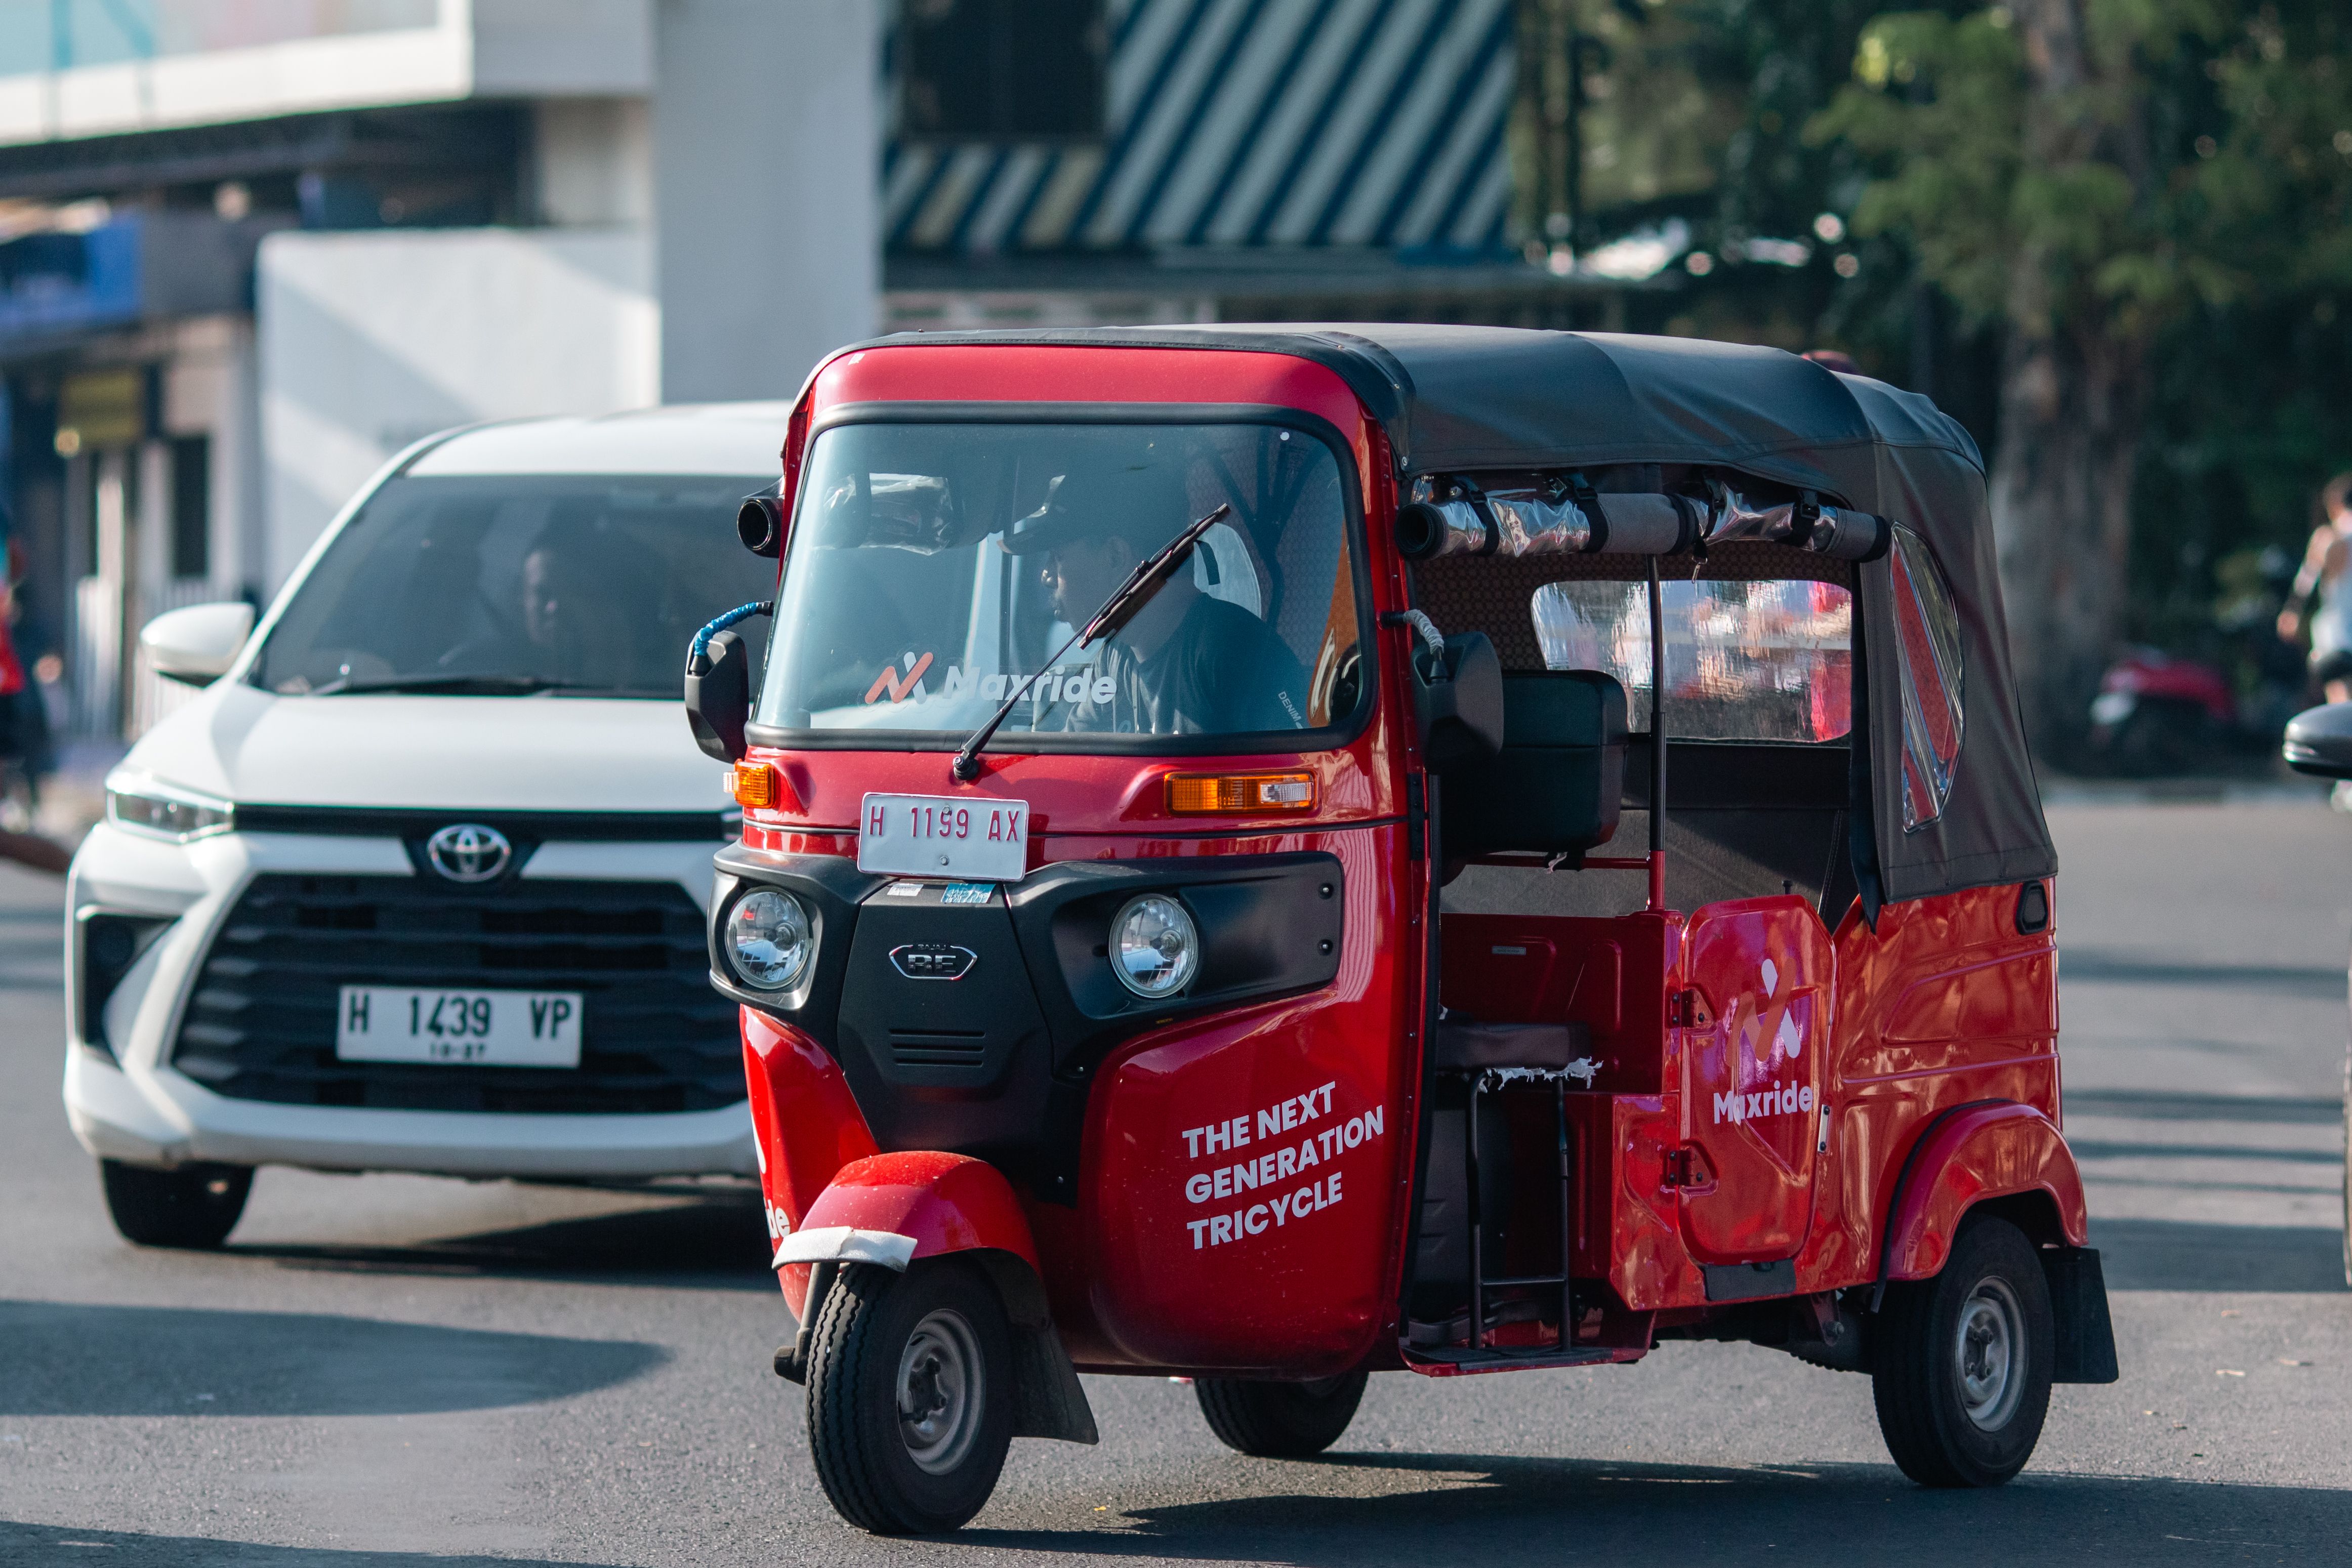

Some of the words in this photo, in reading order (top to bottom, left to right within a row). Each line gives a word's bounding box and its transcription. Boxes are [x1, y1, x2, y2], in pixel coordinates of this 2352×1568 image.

[942, 665, 1118, 705] Maxride
[1278, 691, 1302, 722] DENIM
[870, 806, 884, 836] H
[987, 810, 1019, 841] AX
[907, 954, 957, 973] RE
[347, 992, 370, 1034] H
[408, 995, 492, 1038] 1439
[528, 998, 572, 1041] VP
[1182, 1115, 1251, 1159] THE
[1257, 1081, 1336, 1140] NEXT
[1713, 1080, 1813, 1126] Maxride
[1185, 1104, 1384, 1204] GENERATION
[1186, 1171, 1343, 1250] TRICYCLE
